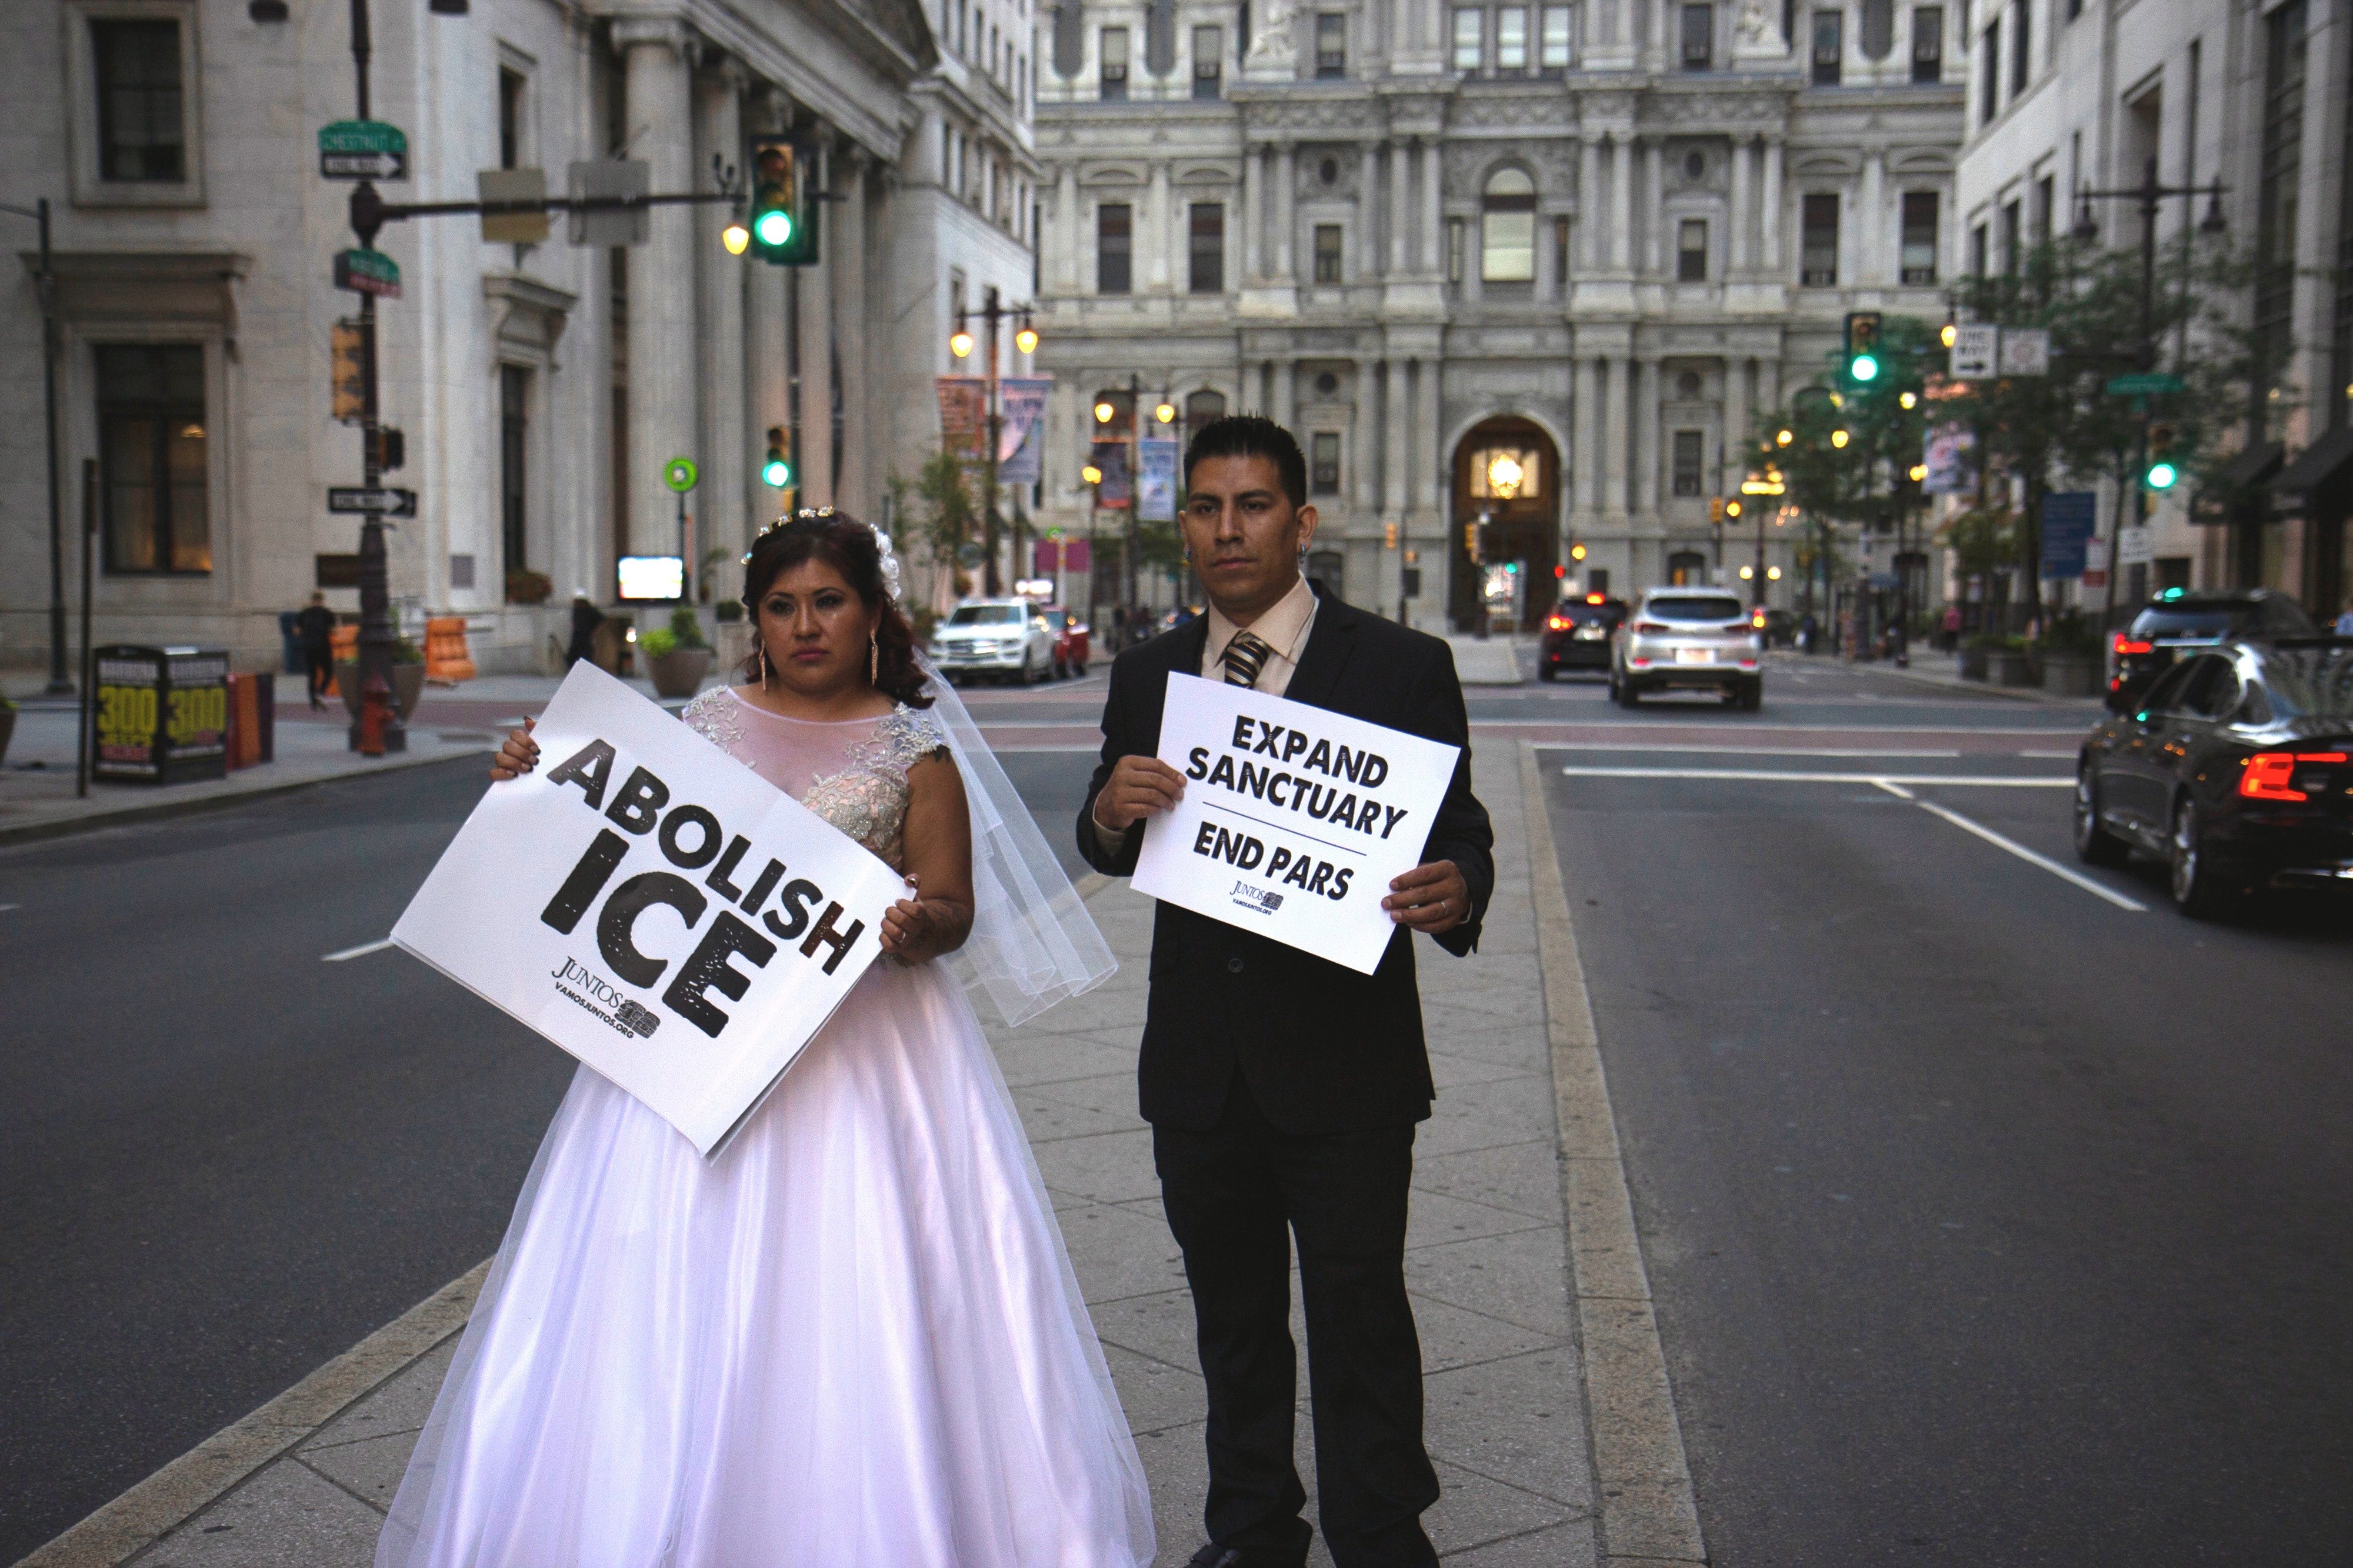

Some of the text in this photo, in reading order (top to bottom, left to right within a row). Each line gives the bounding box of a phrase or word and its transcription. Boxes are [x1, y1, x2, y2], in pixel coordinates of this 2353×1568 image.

[98, 685, 158, 738] 300
[167, 687, 226, 739] 300
[1232, 715, 1388, 788] EXPAND
[1185, 747, 1408, 839] SANCTUARY
[547, 739, 865, 976] ABOLISH
[1194, 821, 1354, 900] END PARS
[1229, 880, 1265, 900] JUNTOS
[541, 828, 777, 1038] ICE
[551, 956, 624, 1008] JUNTOS
[555, 982, 634, 1039] VAMOSJUNTOS.ORG
